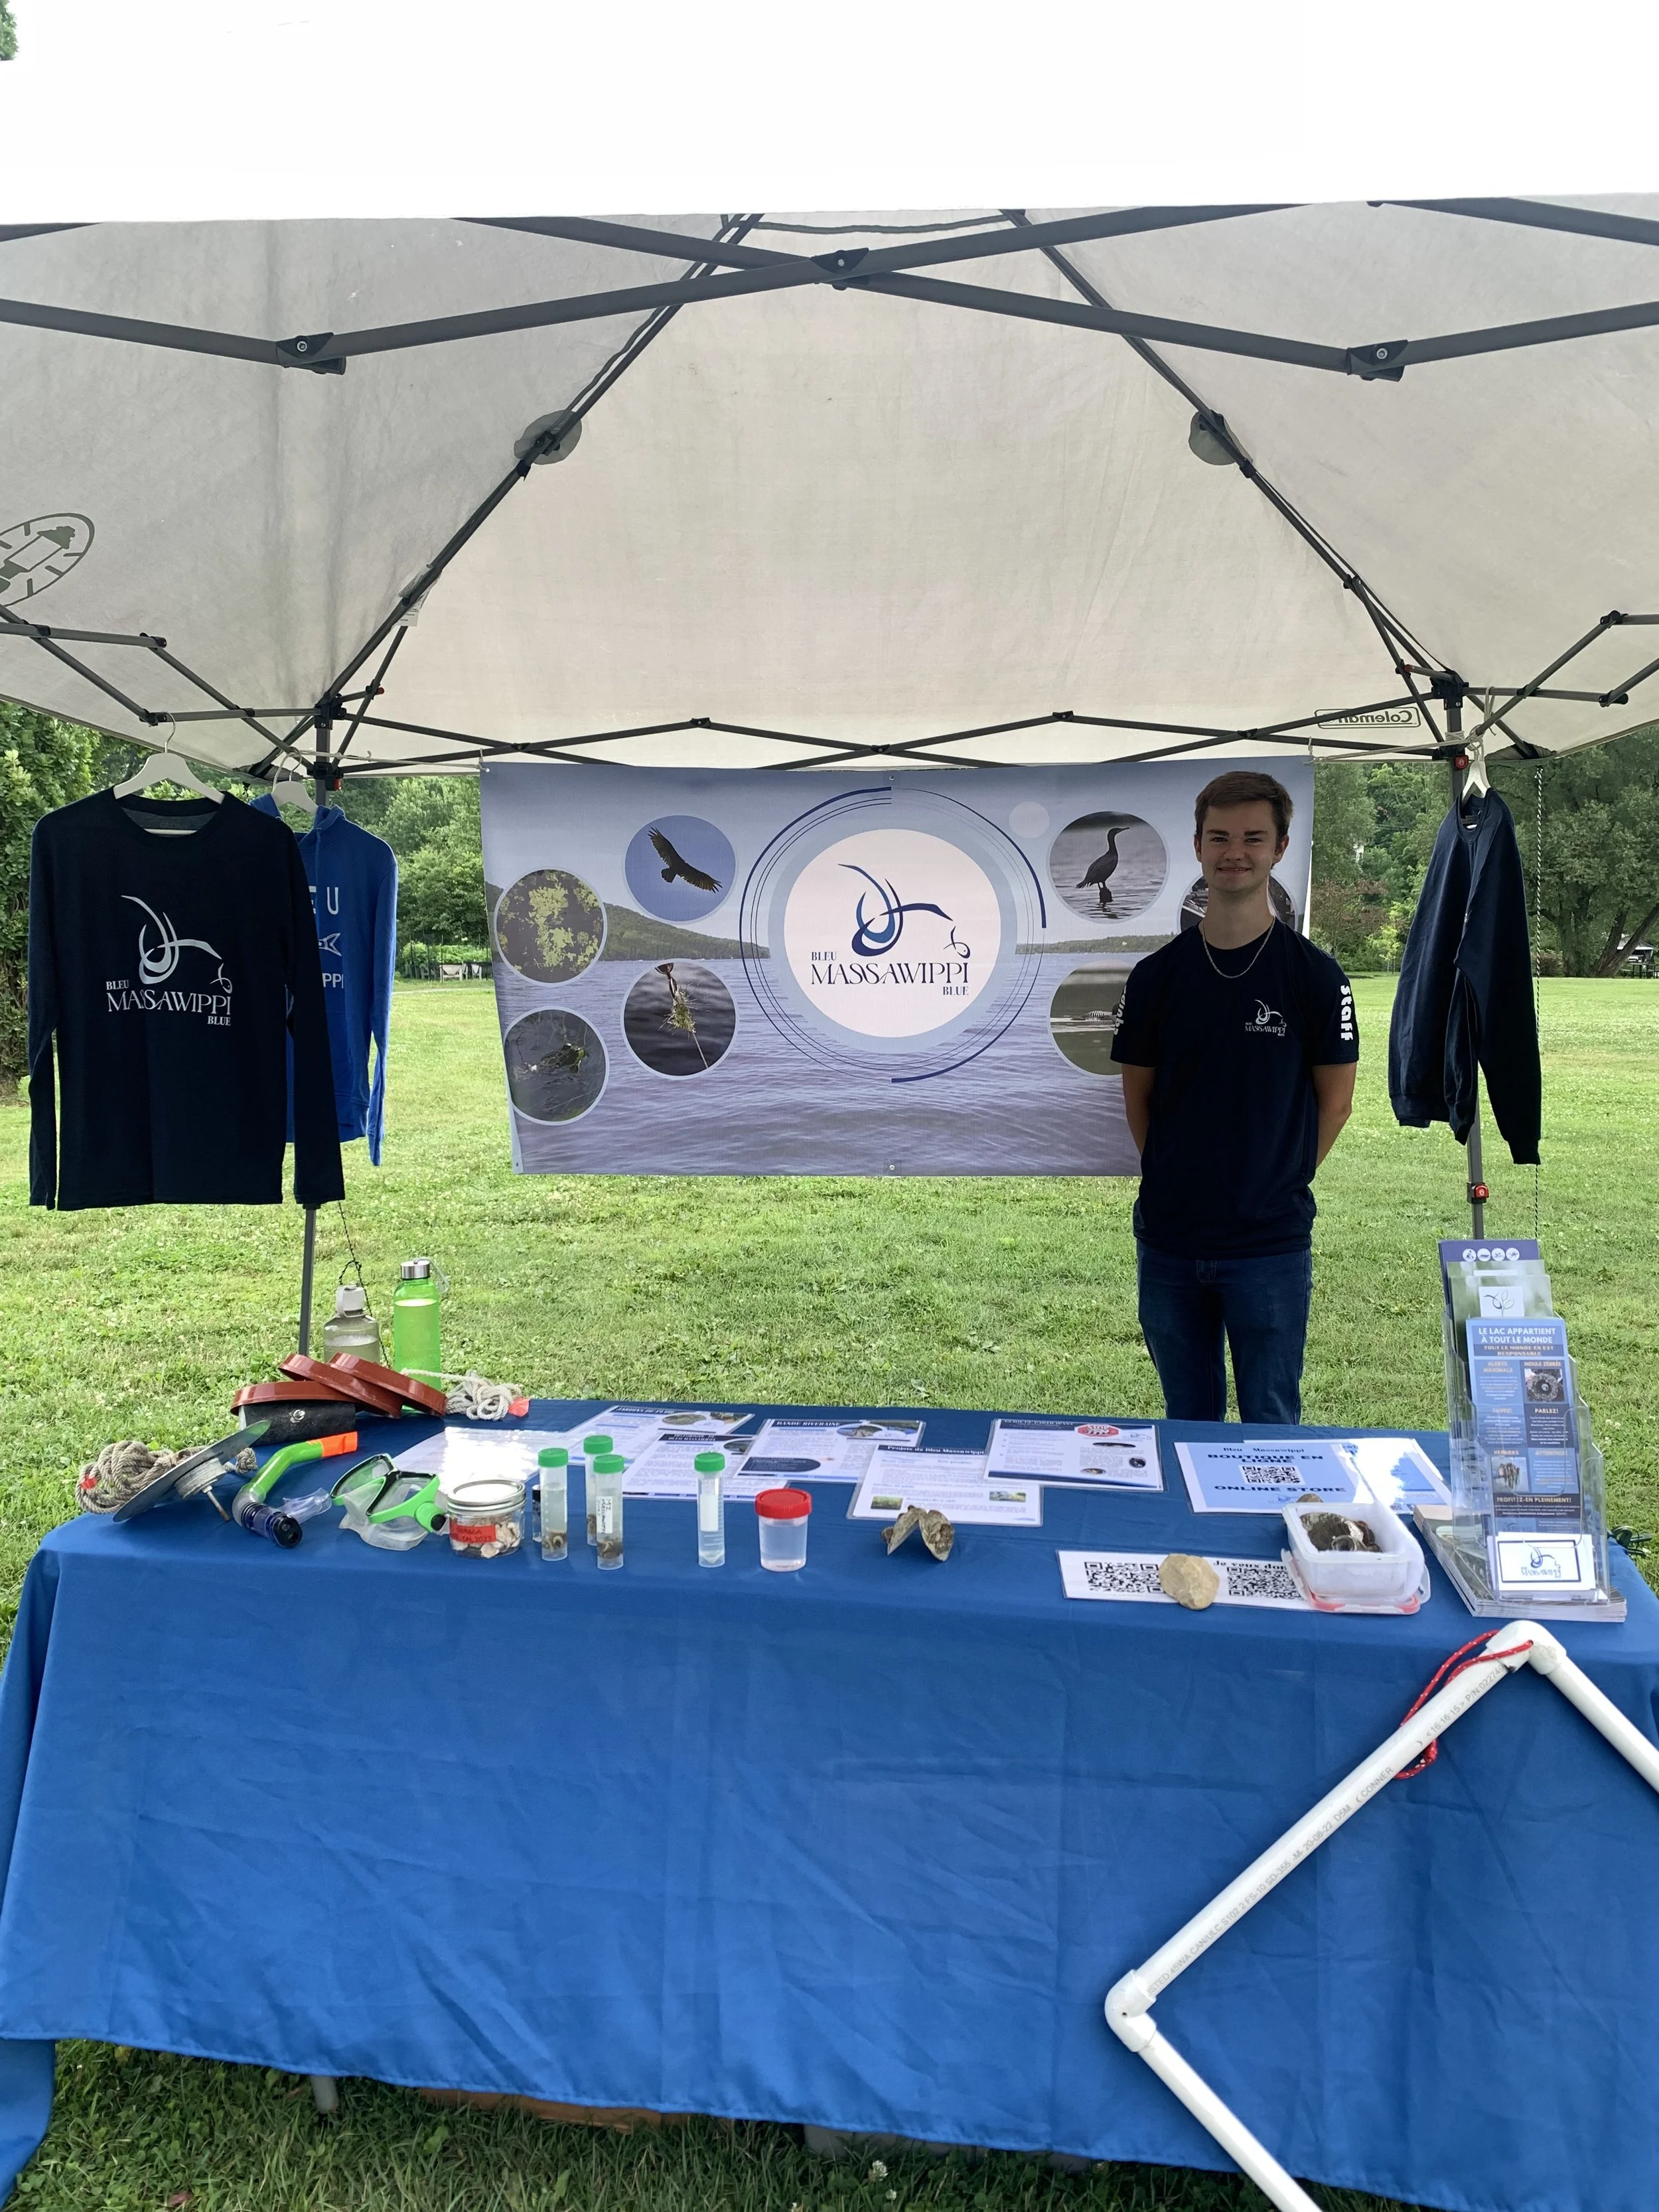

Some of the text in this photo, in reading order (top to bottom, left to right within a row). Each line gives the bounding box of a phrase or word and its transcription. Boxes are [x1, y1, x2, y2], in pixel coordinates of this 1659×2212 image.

[811, 951, 837, 961] BLEU
[811, 962, 969, 985] MASSAWIPPI
[106, 980, 129, 990] BLEU
[942, 986, 969, 995] BLUE
[207, 1015, 232, 1026] BLUE
[1481, 1335, 1488, 1343] À
[1145, 1971, 1171, 1996] ISTED
[1244, 1883, 1267, 1905] FS-10
[1263, 1860, 1292, 1886] SD-355
[1301, 1820, 1334, 1850] 20-08-22
[1359, 1766, 1394, 1798] CONNER
